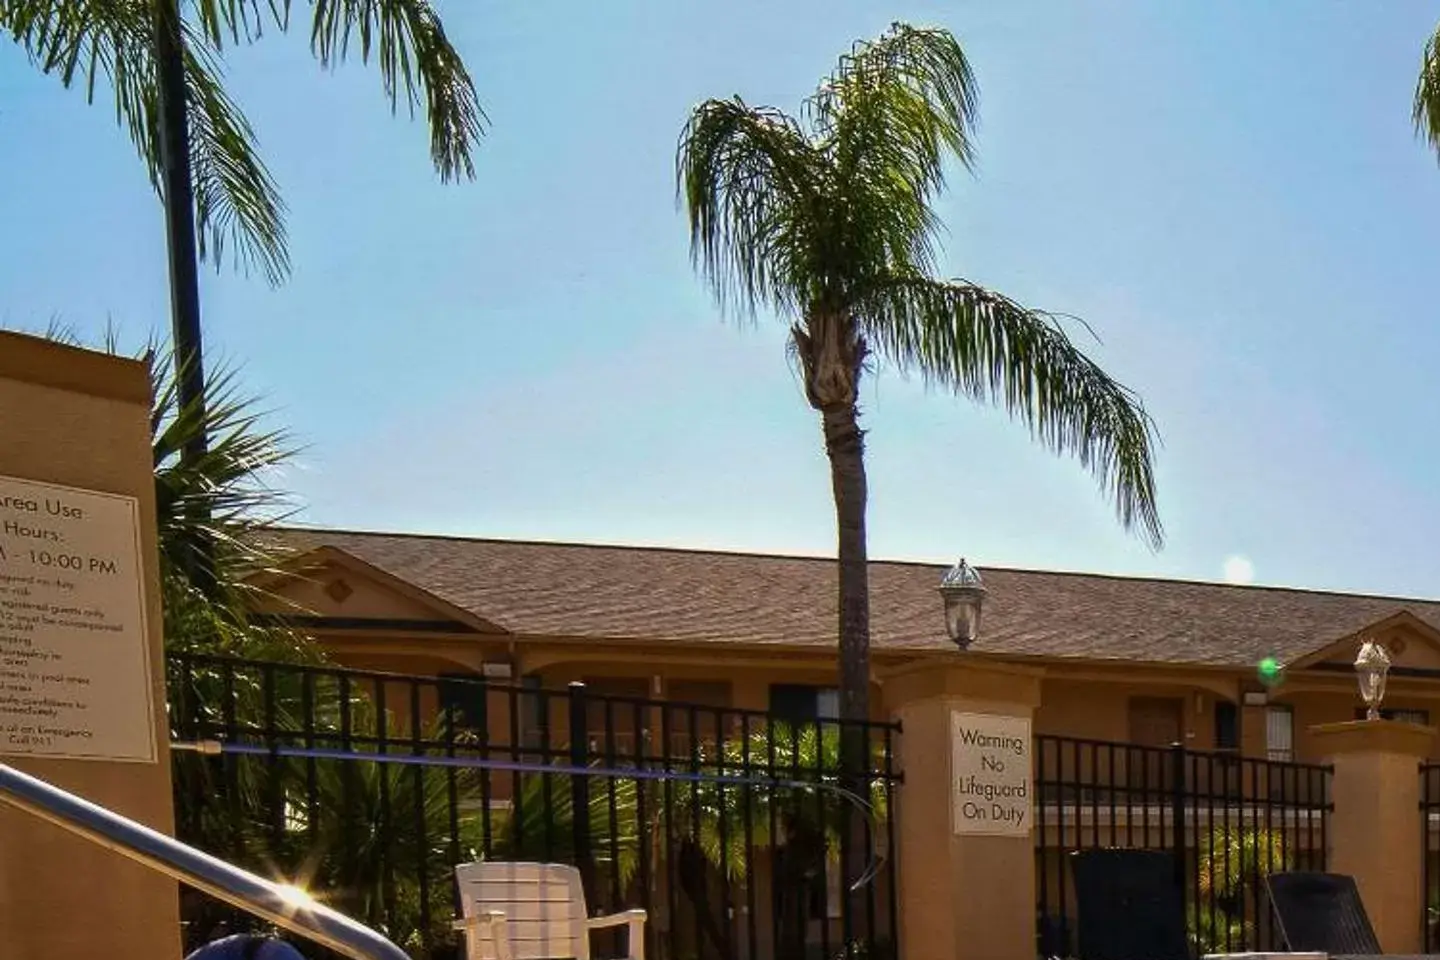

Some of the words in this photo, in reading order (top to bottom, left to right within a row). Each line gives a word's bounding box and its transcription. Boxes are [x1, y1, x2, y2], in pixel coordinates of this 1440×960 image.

[46, 499, 82, 519] Use
[4, 520, 64, 542] Hours:
[30, 550, 82, 569] 10:00
[89, 558, 116, 574] PM
[959, 727, 1024, 755] Warning
[981, 755, 1005, 772] No
[959, 775, 1026, 801] Lifeguard
[963, 802, 986, 819] On
[992, 803, 1025, 826] Duty
